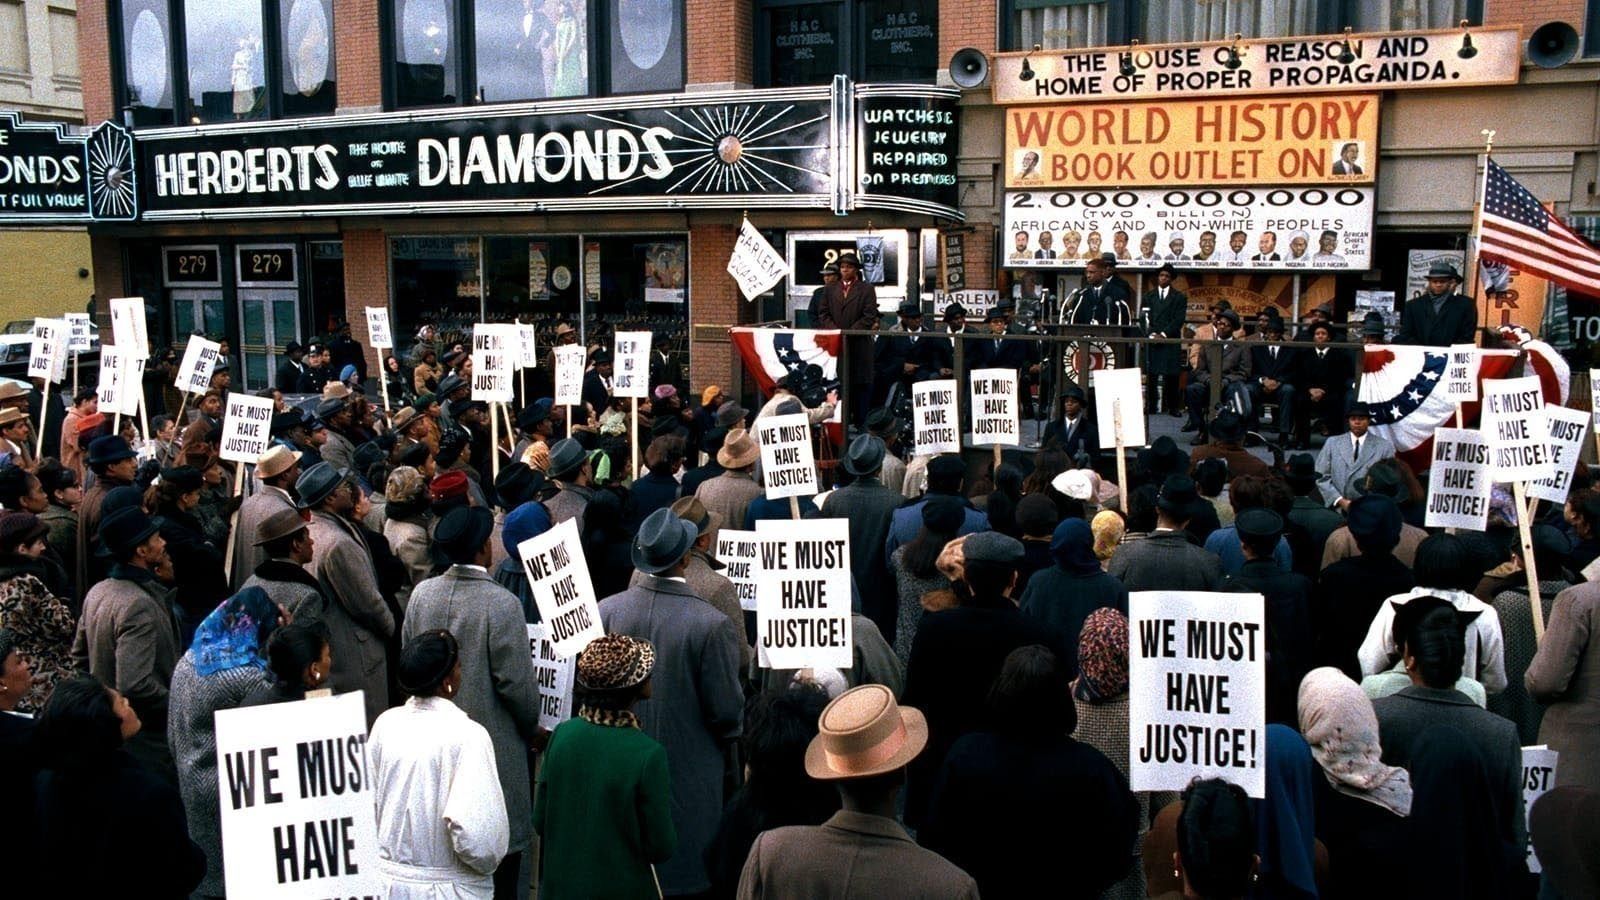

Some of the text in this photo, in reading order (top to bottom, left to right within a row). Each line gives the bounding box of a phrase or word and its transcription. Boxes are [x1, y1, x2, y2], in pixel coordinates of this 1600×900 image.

[810, 20, 819, 31] C
[909, 12, 918, 24] C
[1064, 53, 1107, 73] THE
[1266, 40, 1363, 63] REASON
[1377, 37, 1429, 58] AND
[1036, 60, 1460, 96] HOME OF PROPER PROPAGANDA.
[1012, 100, 1369, 148] WORLD HISTORY
[873, 130, 947, 145] JEWELRY
[418, 126, 675, 187] DIAMONDS
[873, 152, 948, 166] REPAIRED
[1051, 149, 1325, 181] BOOK OUTLET ON
[155, 144, 340, 197] HERBERTS
[45, 194, 86, 207] VALUE
[1083, 207, 1252, 219] (TWO BILLION)
[1011, 218, 1344, 231] AFRICANS AND NON-WHITE PEOPLES
[739, 226, 783, 280] HARLEM
[178, 255, 207, 275] 279
[252, 254, 282, 274] 279
[937, 293, 996, 305] HARLEM
[36, 327, 49, 338] WE
[475, 335, 490, 350] WE
[103, 355, 118, 368] WE
[974, 379, 988, 395] WE
[914, 390, 953, 408] WE MUST
[984, 399, 1008, 415] HAVE
[1502, 390, 1539, 413] MUST
[230, 403, 272, 421] WE MUST
[924, 409, 947, 426] HAVE
[237, 422, 260, 437] HAVE
[761, 425, 807, 446] WE MUST
[917, 428, 956, 446] JUSTICE!
[1497, 419, 1530, 441] HAVE
[1550, 418, 1585, 442] MUST
[225, 437, 265, 455] JUSTICE!
[774, 447, 801, 466] HAVE
[1435, 441, 1451, 462] WE
[768, 466, 813, 488] JUSTICE!
[1443, 468, 1475, 489] HAVE
[1429, 493, 1485, 517] JUSTICE!
[719, 539, 734, 557] WE
[760, 540, 845, 570] WE MUST
[526, 553, 552, 582] WE
[727, 561, 751, 578] HAVE
[551, 574, 579, 607] HAVE
[781, 580, 828, 609] HAVE
[763, 617, 846, 648] JUSTICE!
[1139, 619, 1260, 662] WE MUST
[1167, 672, 1231, 714] HAVE
[1139, 723, 1256, 769] JUSTICE!
[225, 733, 370, 811] WE MUST
[273, 816, 359, 885] HAVE
